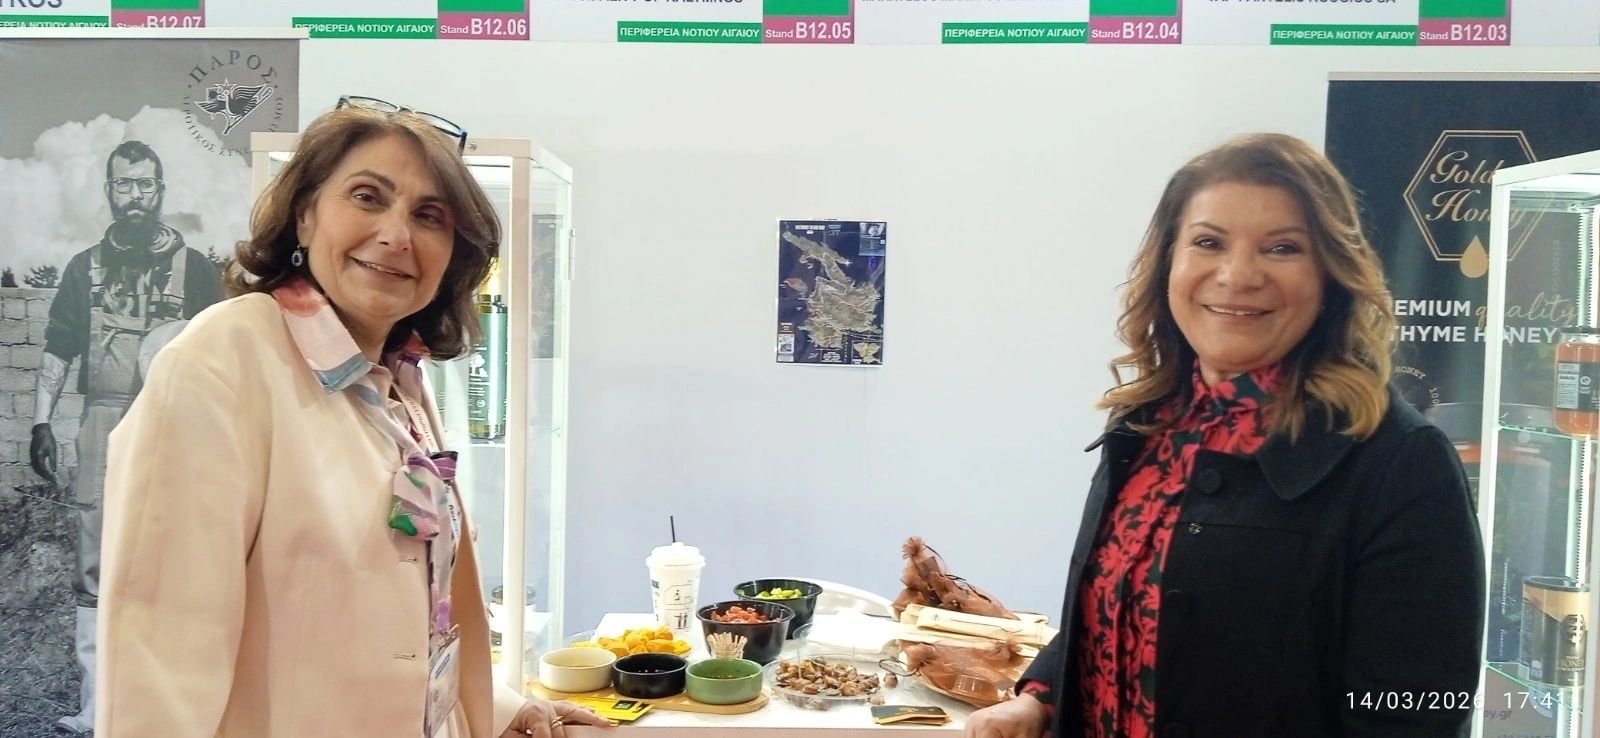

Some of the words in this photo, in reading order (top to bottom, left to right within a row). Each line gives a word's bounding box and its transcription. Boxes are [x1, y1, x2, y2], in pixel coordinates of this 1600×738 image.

[147, 15, 202, 28] B1207
[357, 24, 394, 33] ΝΟΤΙΟΥ
[396, 24, 435, 33] ΑΙΓΑΙΟΥ
[440, 25, 468, 34] Stand
[471, 18, 526, 35] B12.06
[620, 27, 680, 37] ΠΕΡΙΦΕΡΕΙΑ
[682, 28, 719, 37] ΝΟΤΙΟΥ
[721, 28, 759, 37] ΑΙΓΑΙΟΥ
[765, 29, 793, 38] Stand
[796, 22, 851, 39] B12.05
[944, 29, 1005, 37] ΠΕΡΙΦΕΡΕΙΑ
[1007, 28, 1044, 37] ΝΟΤΙΟΥ
[1047, 28, 1086, 37] ΑΙΓΑΙΟΥ
[1091, 29, 1120, 38] Stand
[1122, 22, 1179, 39] B12.04
[1272, 30, 1334, 39] ΠΕΡΙΦΕΡΕΙΑ
[1336, 31, 1374, 39] ΝΟΤΙΟΥ
[1376, 31, 1415, 40] ΑΙΓΑΙΟΥ
[1420, 32, 1448, 40] Stand
[1451, 24, 1507, 41] B12.03
[188, 50, 278, 84] ΠΑΡΟΣ
[1394, 300, 1471, 316] EMIUM
